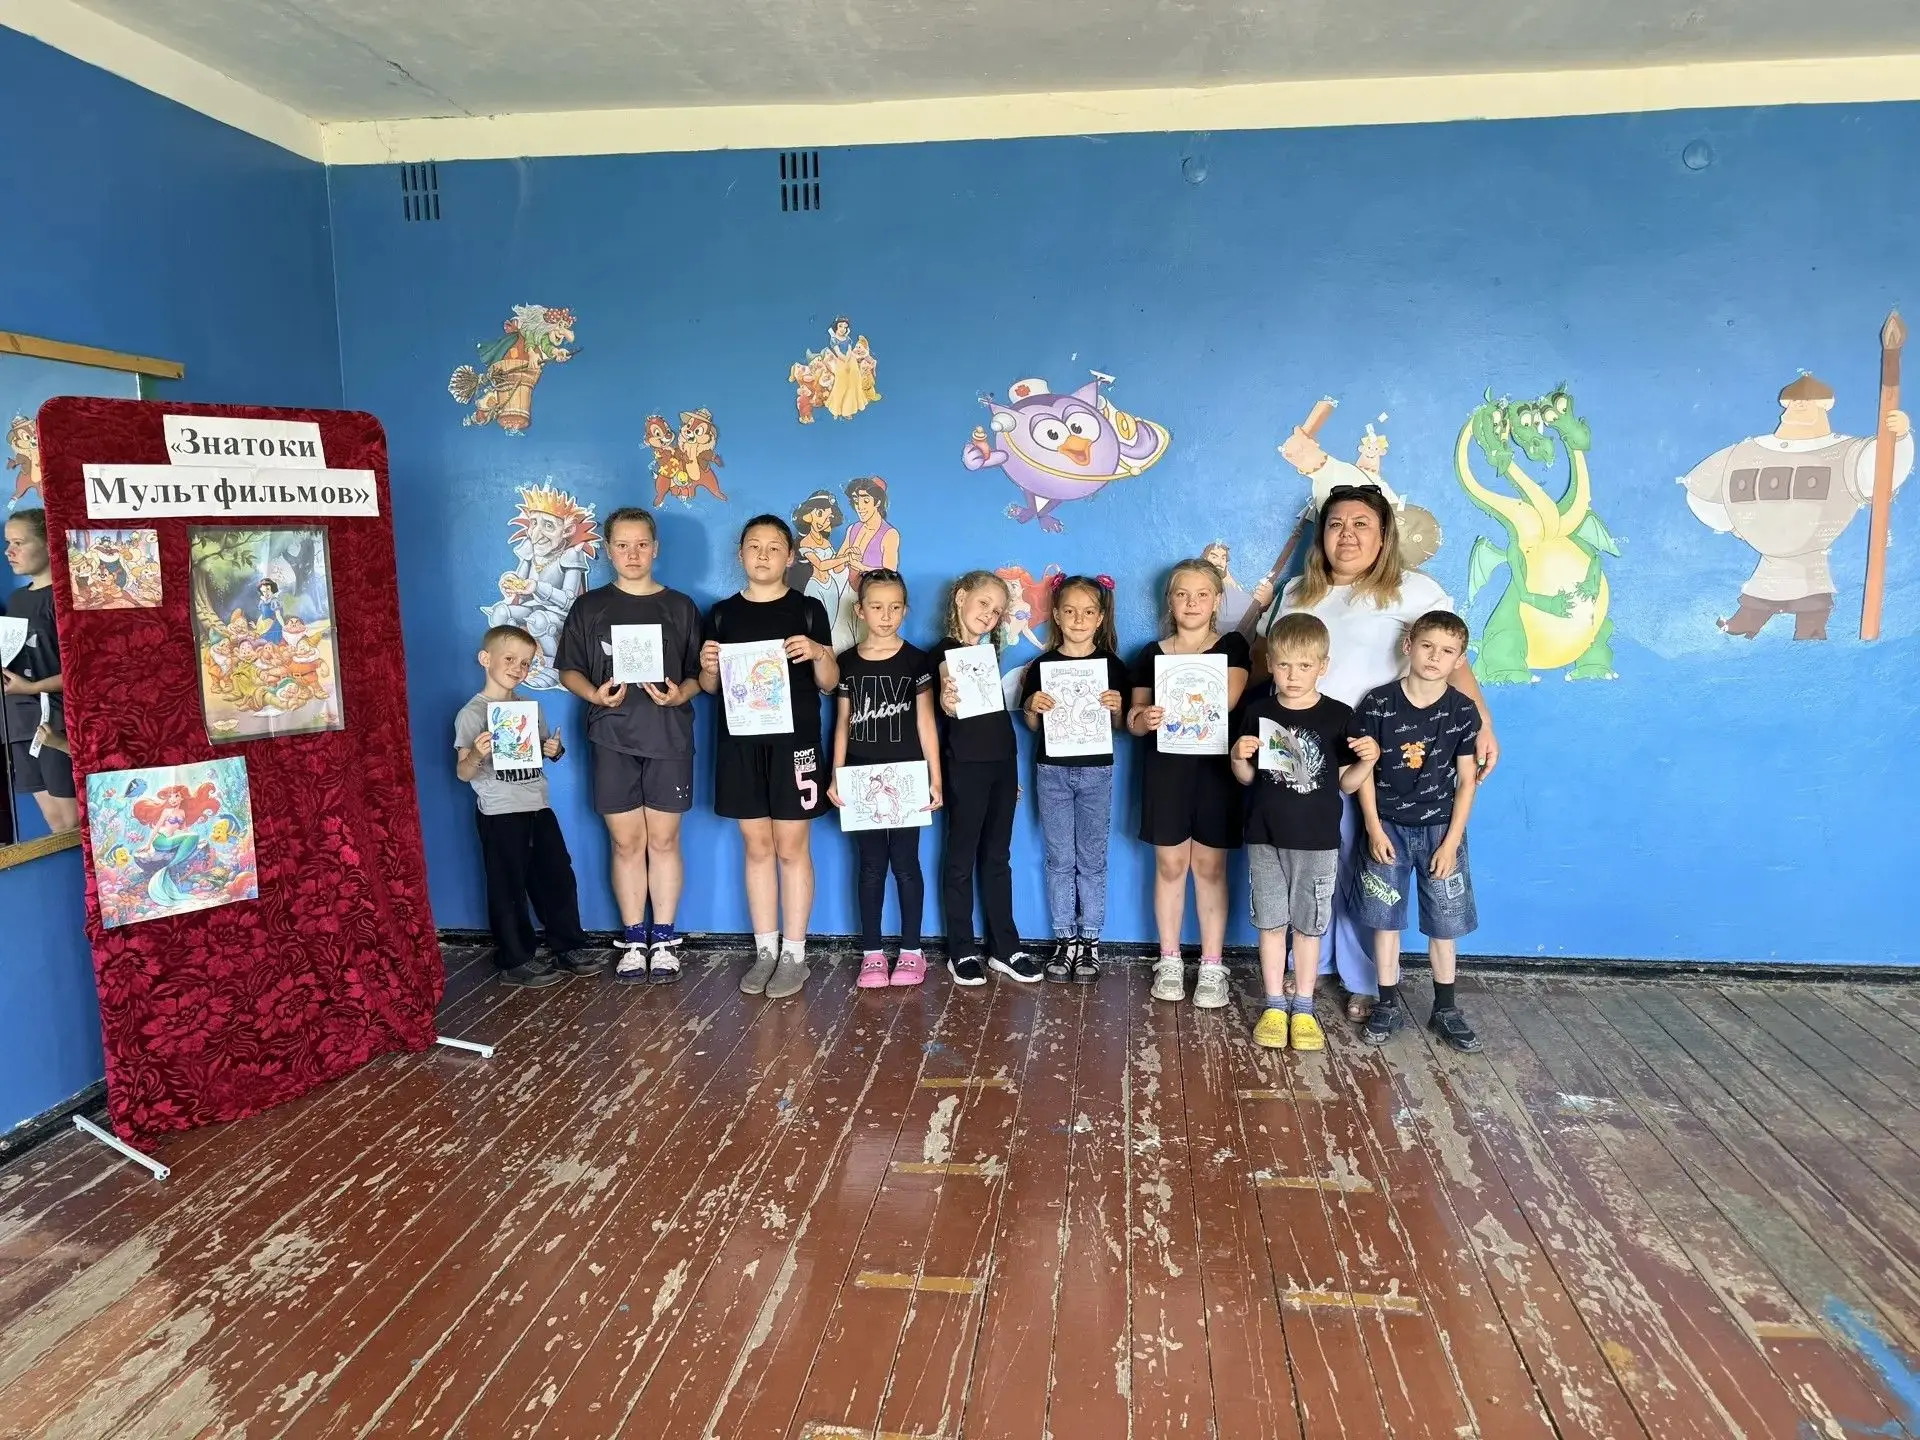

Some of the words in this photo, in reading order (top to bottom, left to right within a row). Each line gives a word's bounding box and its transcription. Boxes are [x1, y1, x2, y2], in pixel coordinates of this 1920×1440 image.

[170, 427, 317, 458] «Знатоки
[88, 476, 370, 511] Мультфильмов»
[793, 755, 816, 766] STOP
[795, 762, 818, 811] 5
